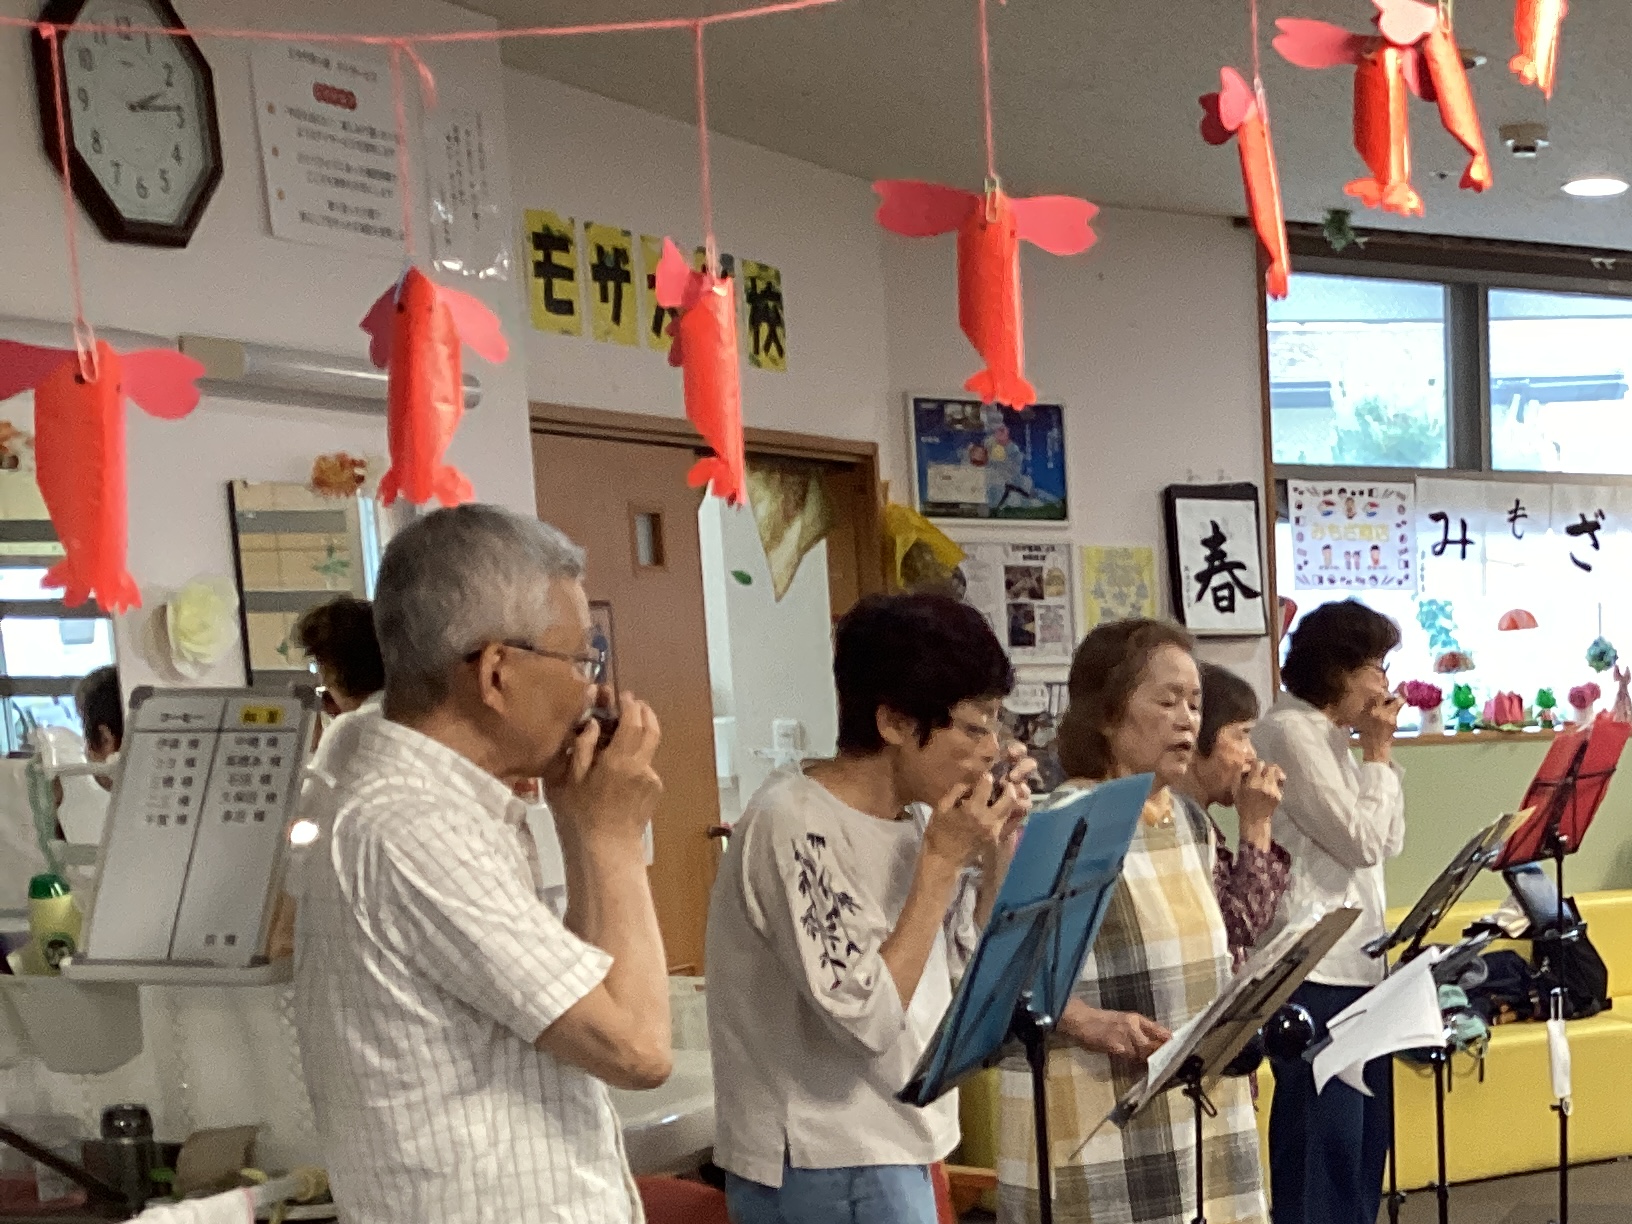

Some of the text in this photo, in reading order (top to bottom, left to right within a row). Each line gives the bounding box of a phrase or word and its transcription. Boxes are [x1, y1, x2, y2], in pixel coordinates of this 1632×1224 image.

[78, 47, 94, 72] 10
[162, 61, 174, 88] 2
[77, 86, 89, 112] 9
[91, 128, 102, 155] 8
[171, 144, 183, 168] 4
[110, 160, 122, 186] 7
[159, 168, 170, 194] 5
[135, 176, 149, 199] 6
[531, 228, 785, 358] モザ校
[1194, 520, 1261, 613] 春
